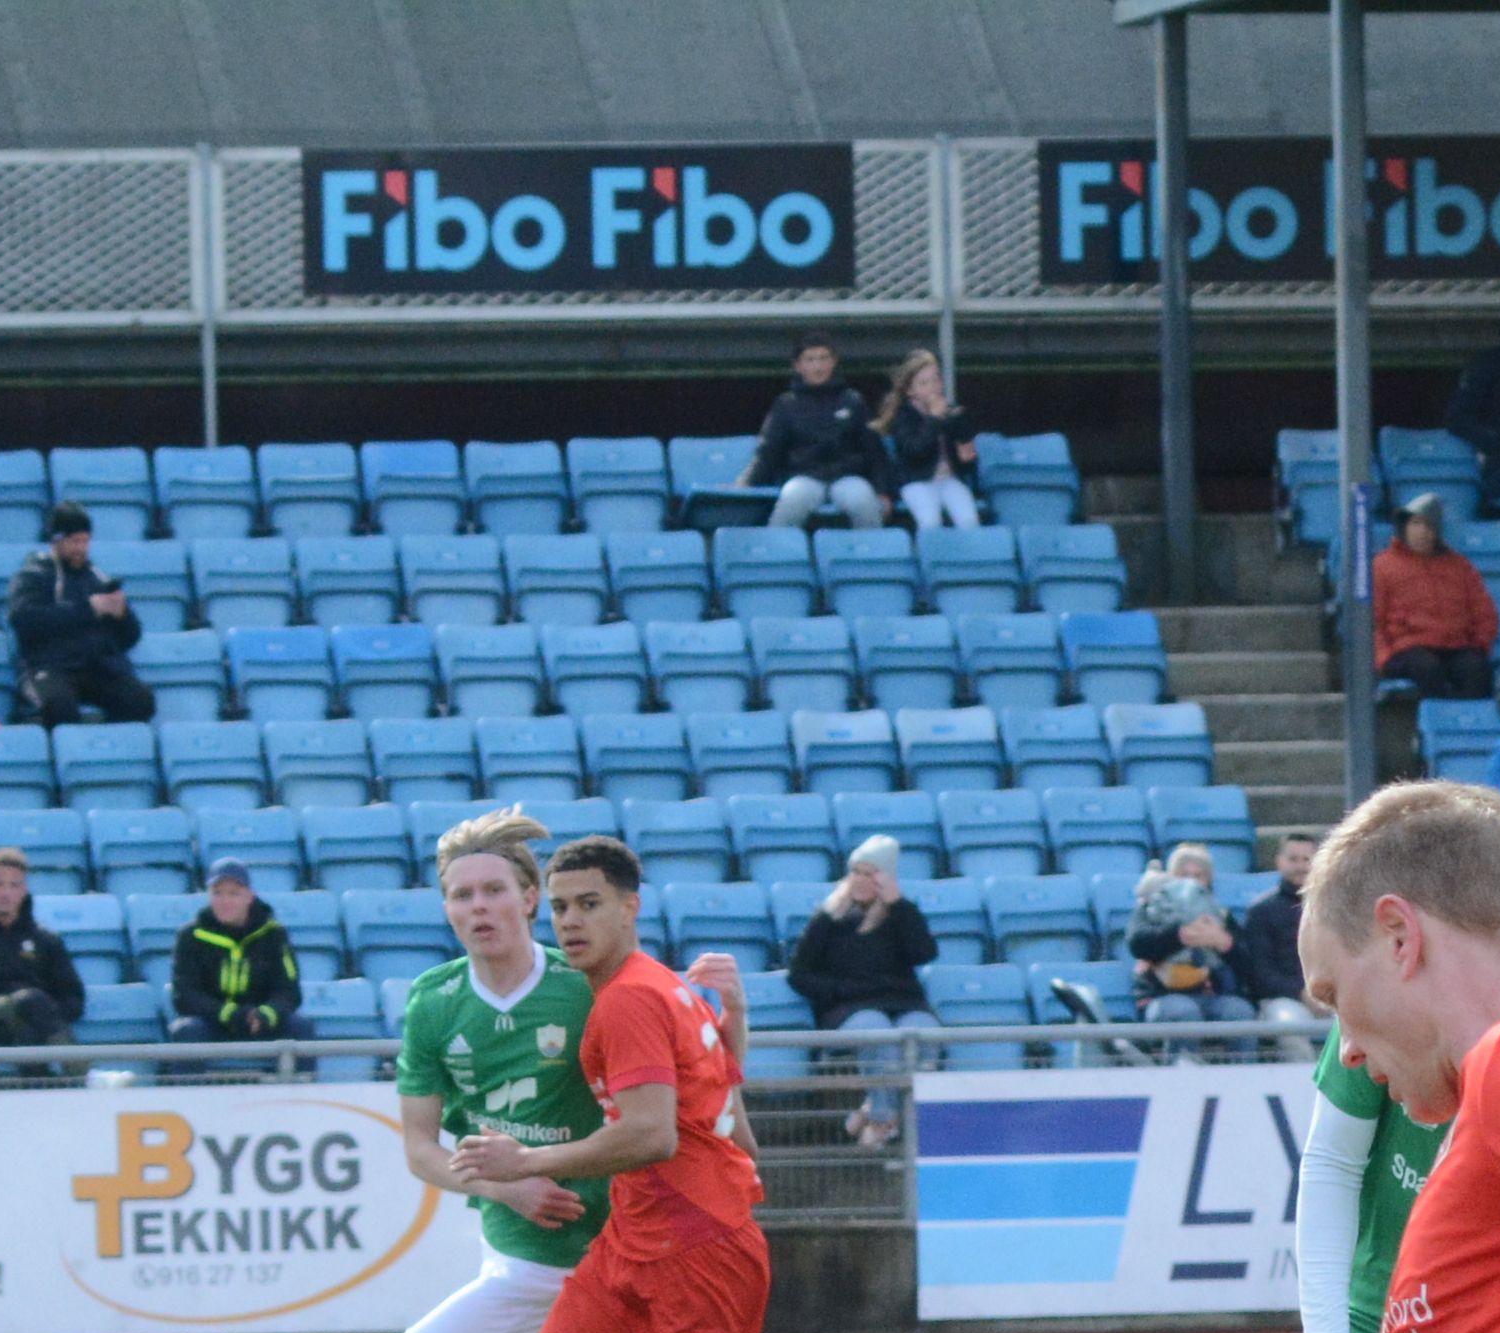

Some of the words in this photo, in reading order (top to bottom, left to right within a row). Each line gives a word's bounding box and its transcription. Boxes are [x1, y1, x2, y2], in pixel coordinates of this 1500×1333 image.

[323, 169, 566, 271] Fibo
[591, 167, 834, 268] Fibo
[116, 1111, 360, 1200] BYGG
[72, 1175, 362, 1258] TEKNIKK
[208, 1264, 235, 1286] 27
[244, 1262, 283, 1285] 137
